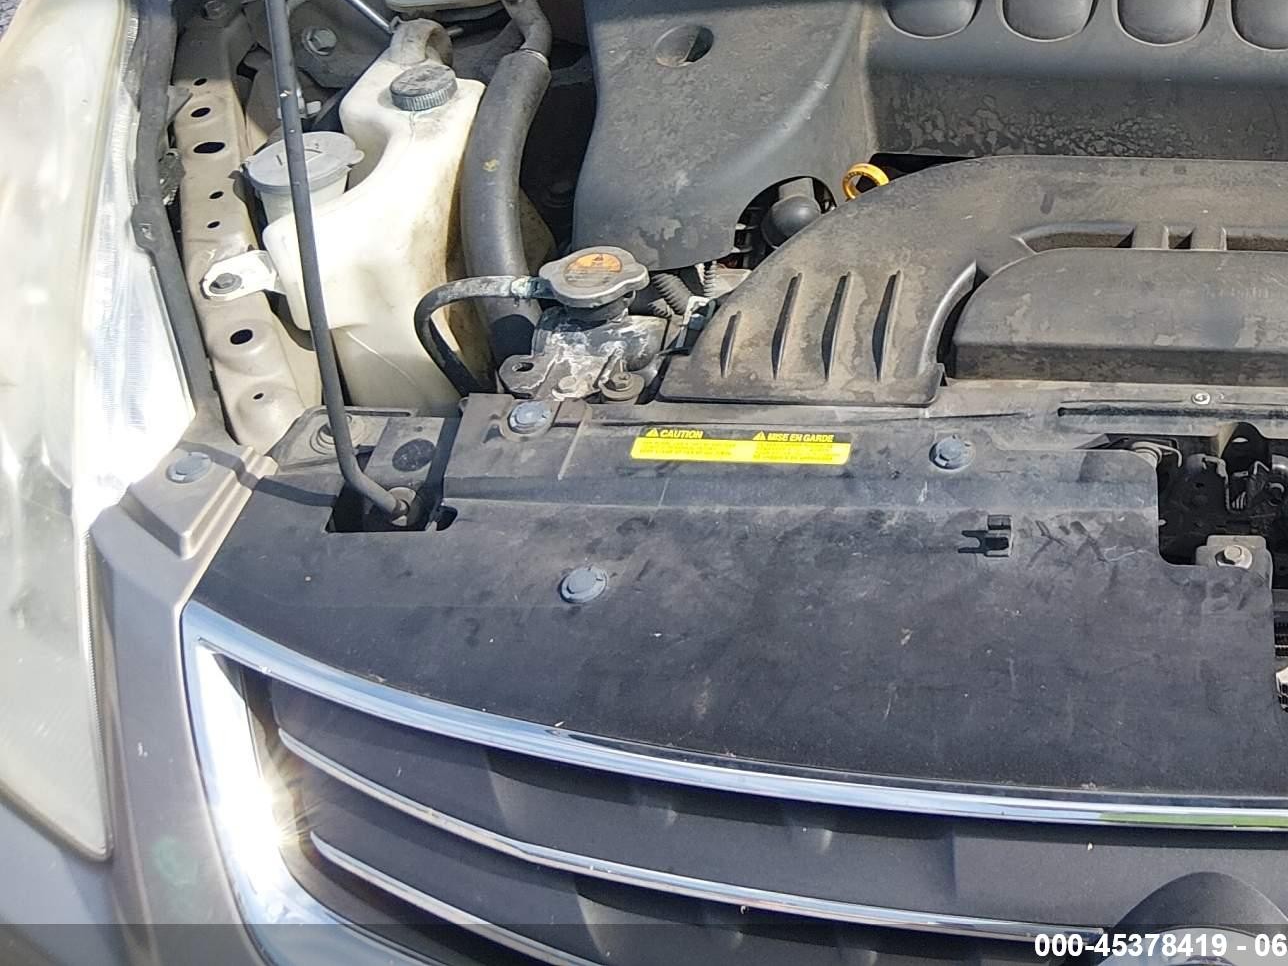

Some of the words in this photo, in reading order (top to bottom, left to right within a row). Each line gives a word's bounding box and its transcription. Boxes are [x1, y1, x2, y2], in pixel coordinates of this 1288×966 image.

[660, 429, 704, 439] CAUTION
[767, 433, 789, 441] MISE
[790, 434, 803, 442] EN
[803, 434, 834, 443] GARDE
